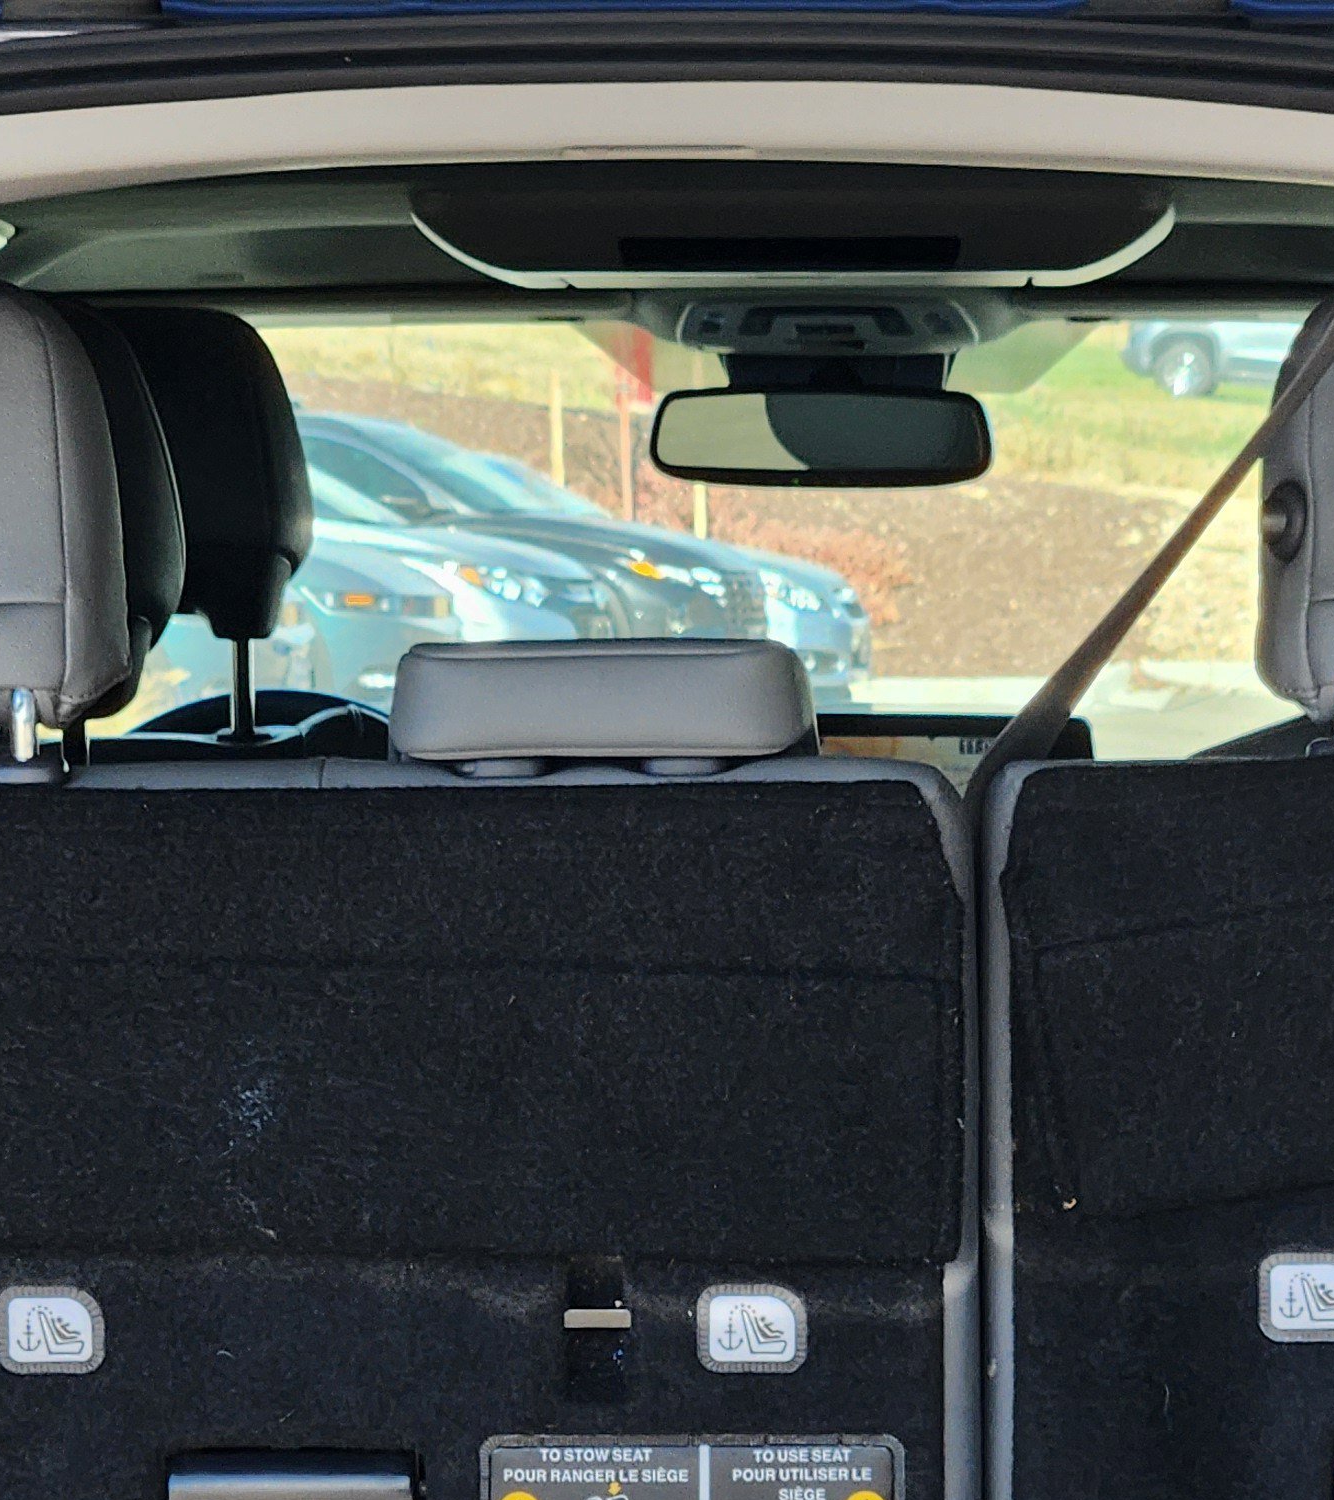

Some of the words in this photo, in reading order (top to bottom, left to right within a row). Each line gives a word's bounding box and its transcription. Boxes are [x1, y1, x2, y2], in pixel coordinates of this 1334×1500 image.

[540, 1448, 562, 1463] TO
[564, 1448, 611, 1463] STOW
[612, 1448, 653, 1463] SEAT
[753, 1449, 775, 1463] TO
[776, 1449, 808, 1463] USE
[810, 1449, 852, 1463] SEAT
[503, 1468, 548, 1483] POUR
[550, 1468, 617, 1483] RANGER
[619, 1468, 643, 1483] LE
[732, 1467, 777, 1482] POUR
[779, 1467, 848, 1482] UTILISER
[850, 1467, 873, 1482] LE
